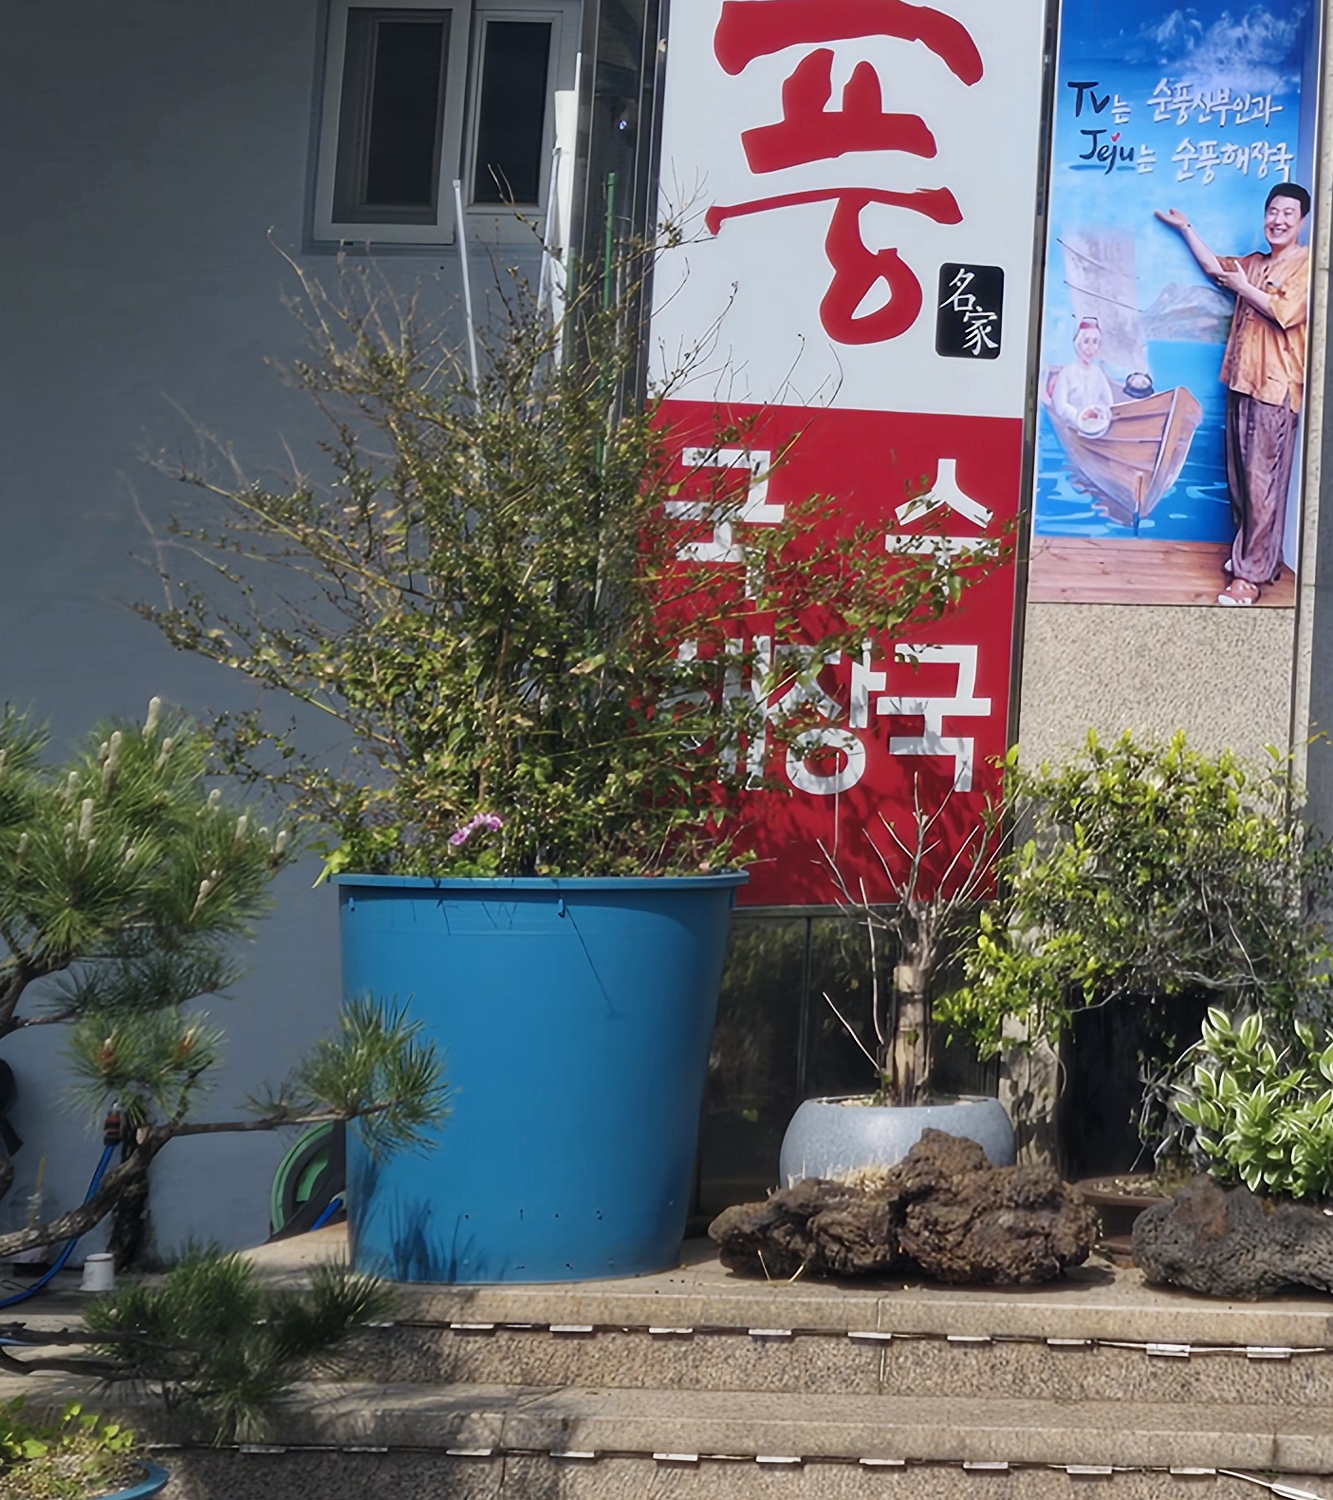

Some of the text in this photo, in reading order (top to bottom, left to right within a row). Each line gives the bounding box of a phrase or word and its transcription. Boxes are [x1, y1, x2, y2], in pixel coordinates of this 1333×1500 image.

[1146, 77, 1285, 128] 순풍산부인과
[1170, 137, 1295, 185] 순풍해장국
[939, 266, 1002, 356] 名家
